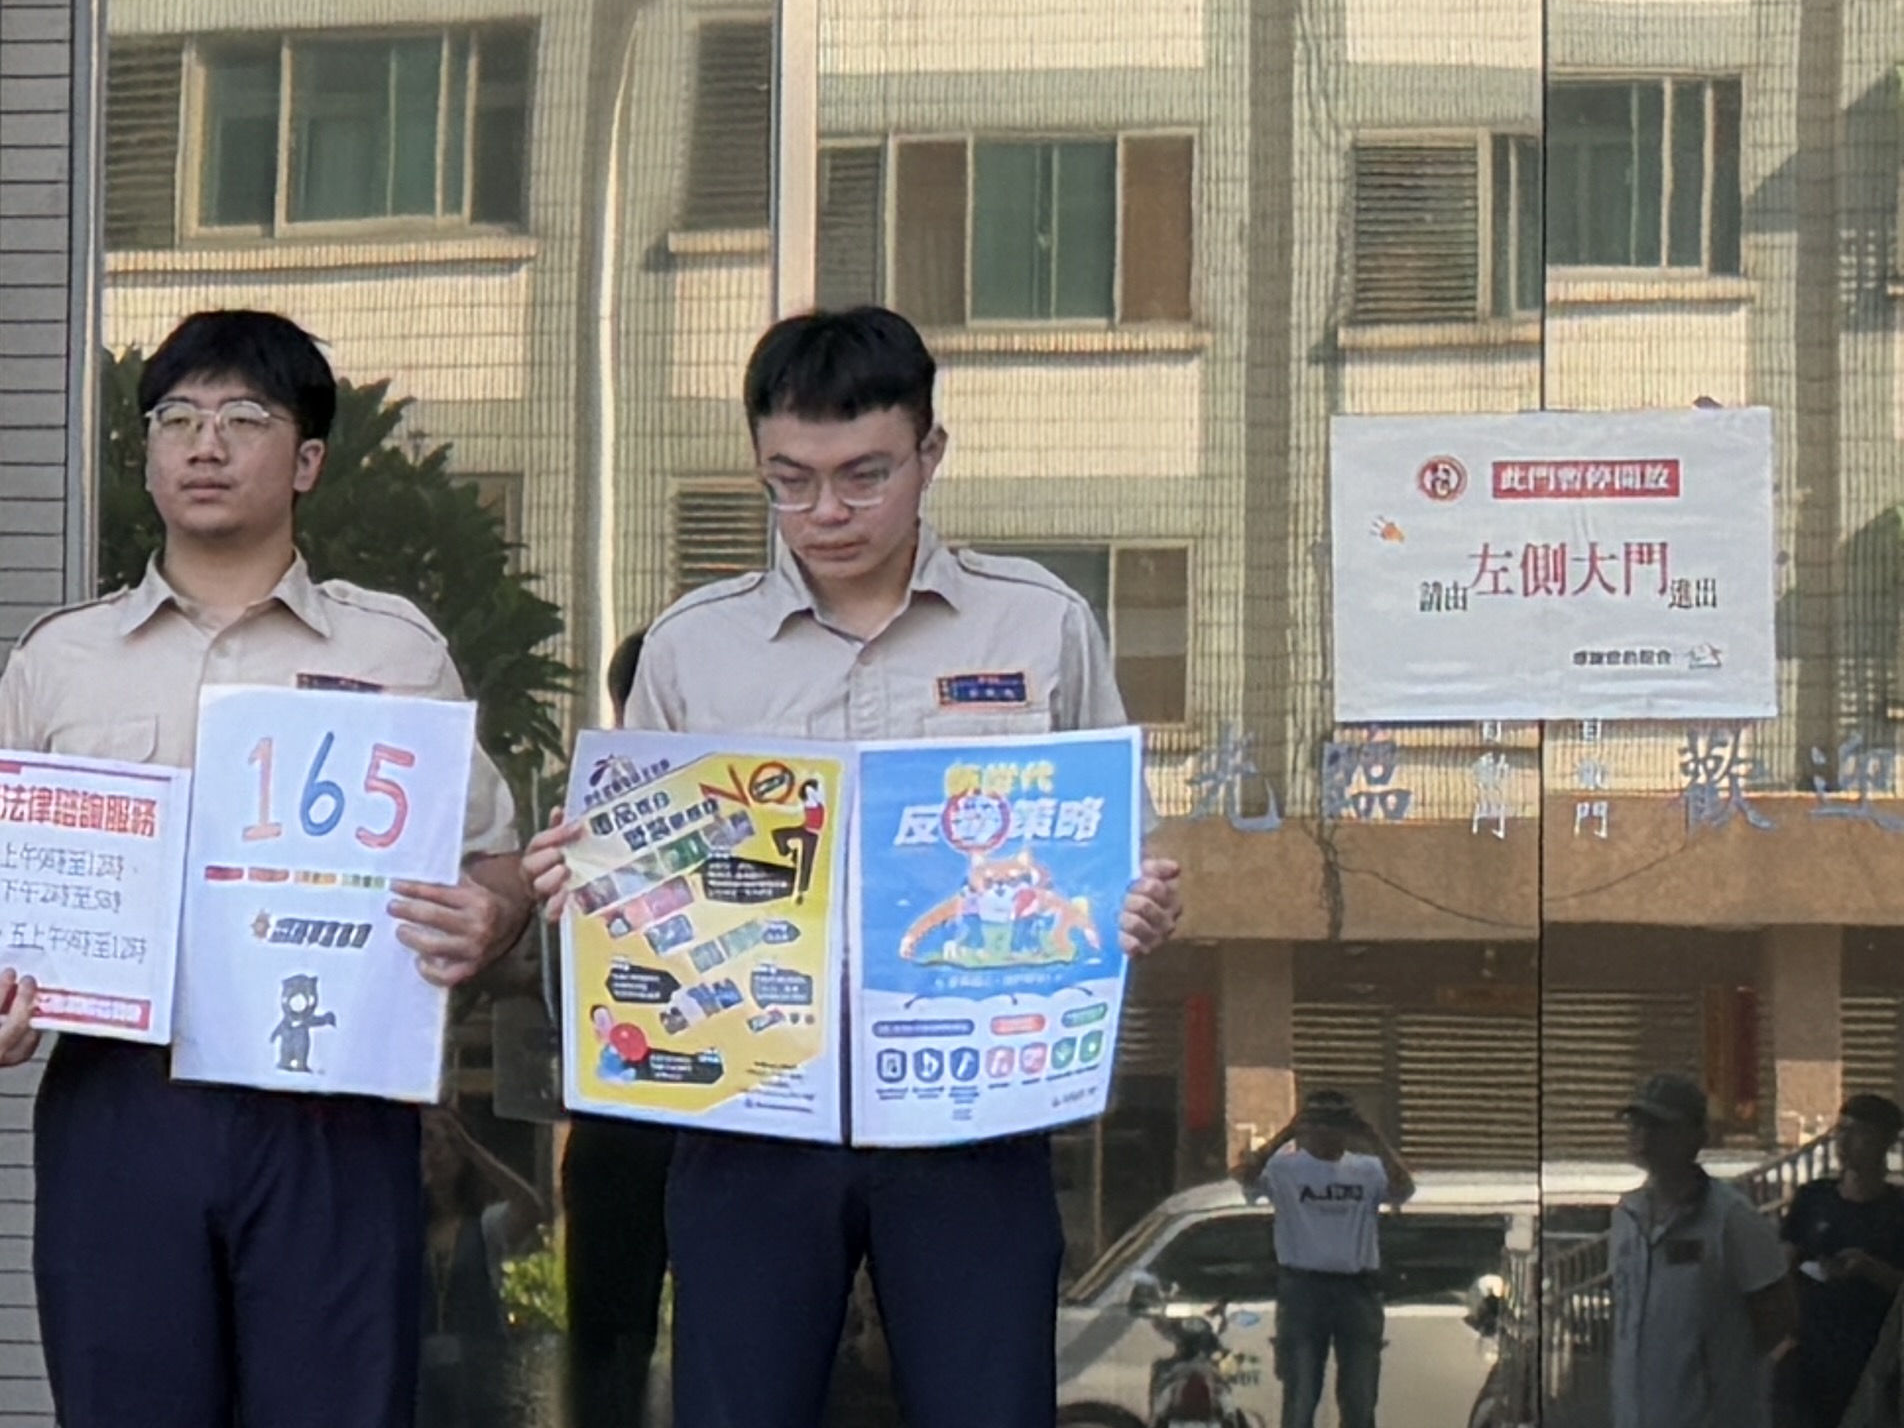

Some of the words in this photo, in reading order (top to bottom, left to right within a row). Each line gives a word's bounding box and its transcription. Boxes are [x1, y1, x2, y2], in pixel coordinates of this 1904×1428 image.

[1418, 541, 1718, 612] 請由左側大門進出
[242, 730, 417, 850] 165
